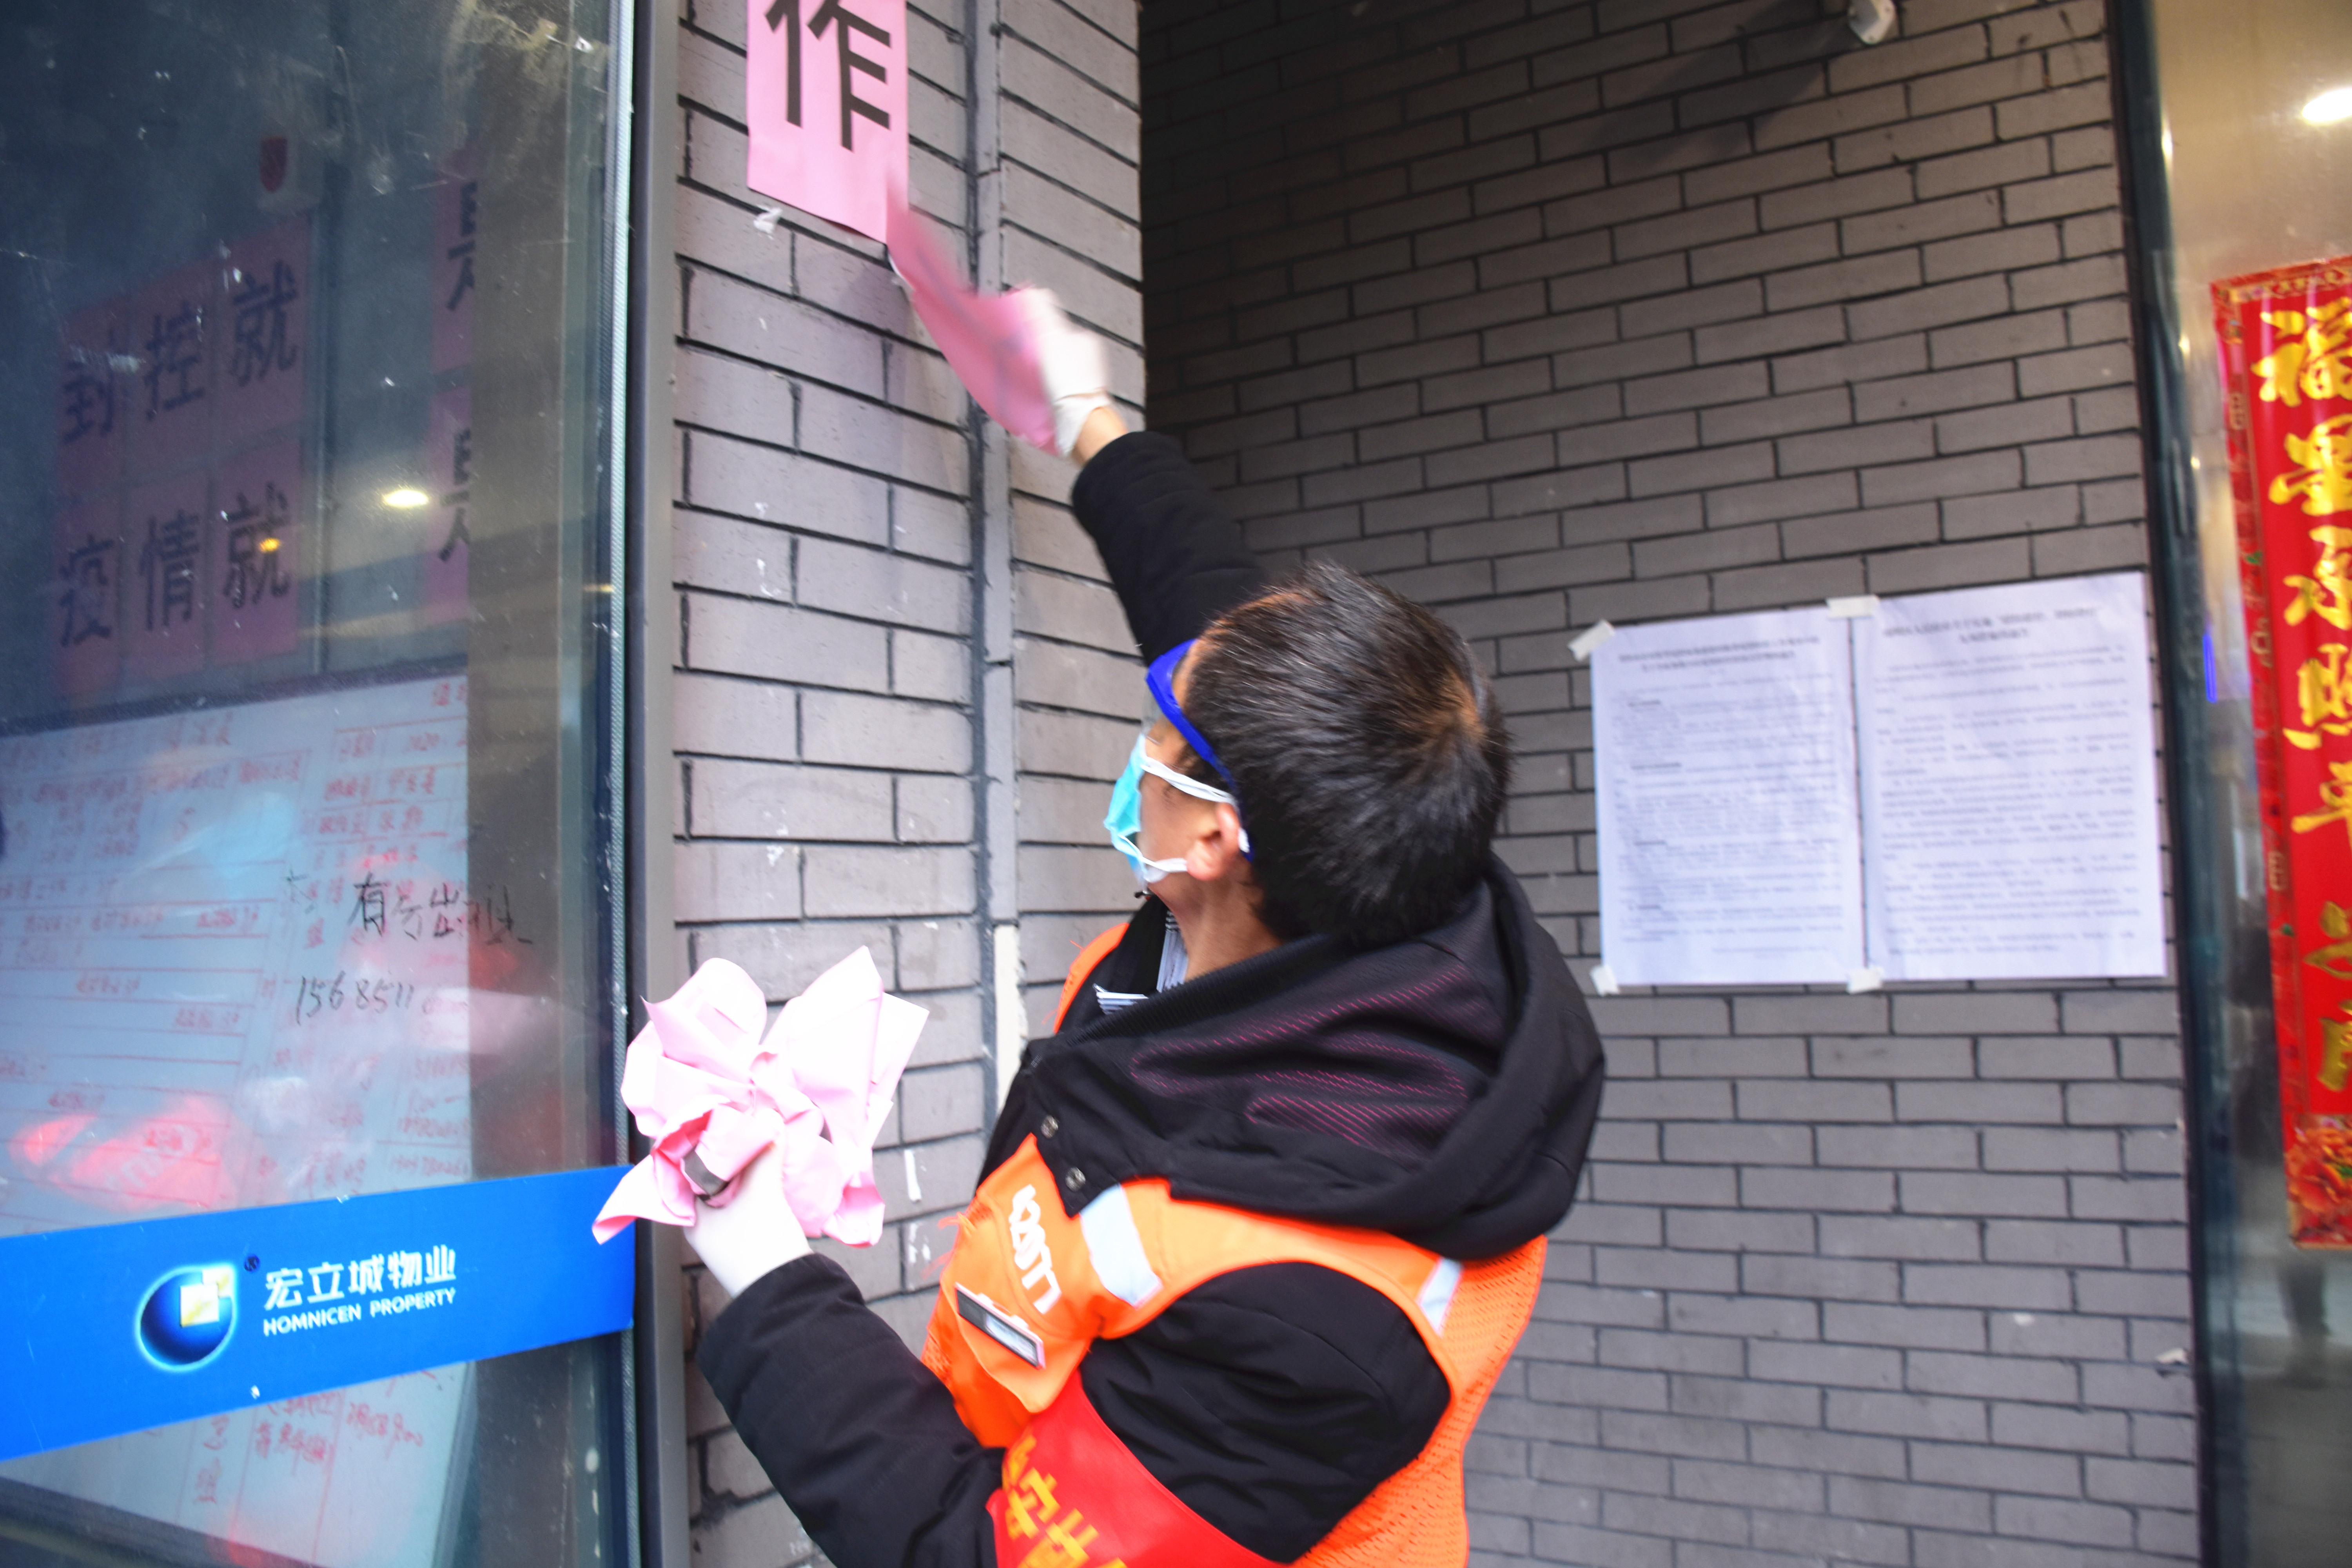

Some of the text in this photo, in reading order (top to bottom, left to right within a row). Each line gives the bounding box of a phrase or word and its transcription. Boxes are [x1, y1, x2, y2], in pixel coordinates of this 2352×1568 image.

[765, 0, 891, 153] 作
[264, 1244, 457, 1311] 宏立城物业
[263, 1287, 456, 1337] HOMNICEN PROPERTY
